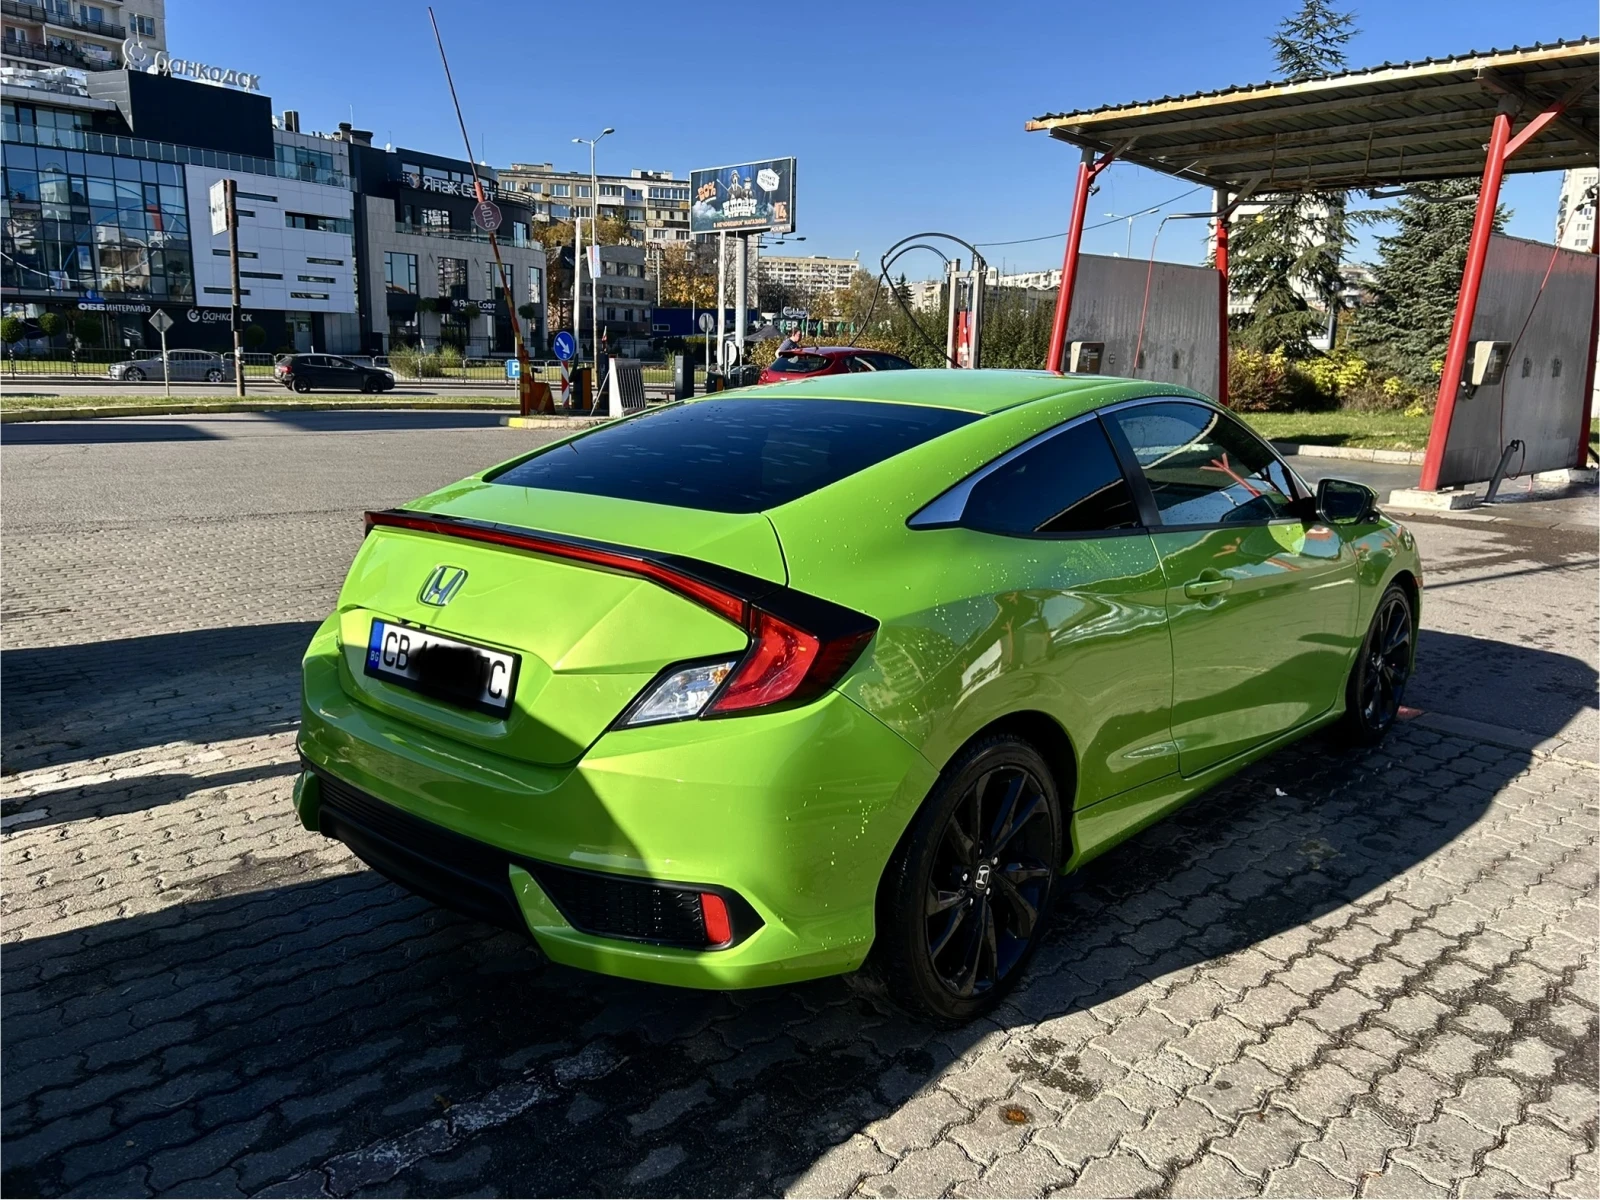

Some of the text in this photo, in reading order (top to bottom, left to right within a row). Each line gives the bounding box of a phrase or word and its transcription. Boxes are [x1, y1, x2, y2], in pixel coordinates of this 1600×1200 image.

[480, 204, 496, 228] STOP
[78, 303, 106, 311] ОББ
[202, 309, 253, 322] банкаск
[512, 363, 520, 375] P
[370, 650, 380, 662] BG
[383, 631, 410, 671] CB
